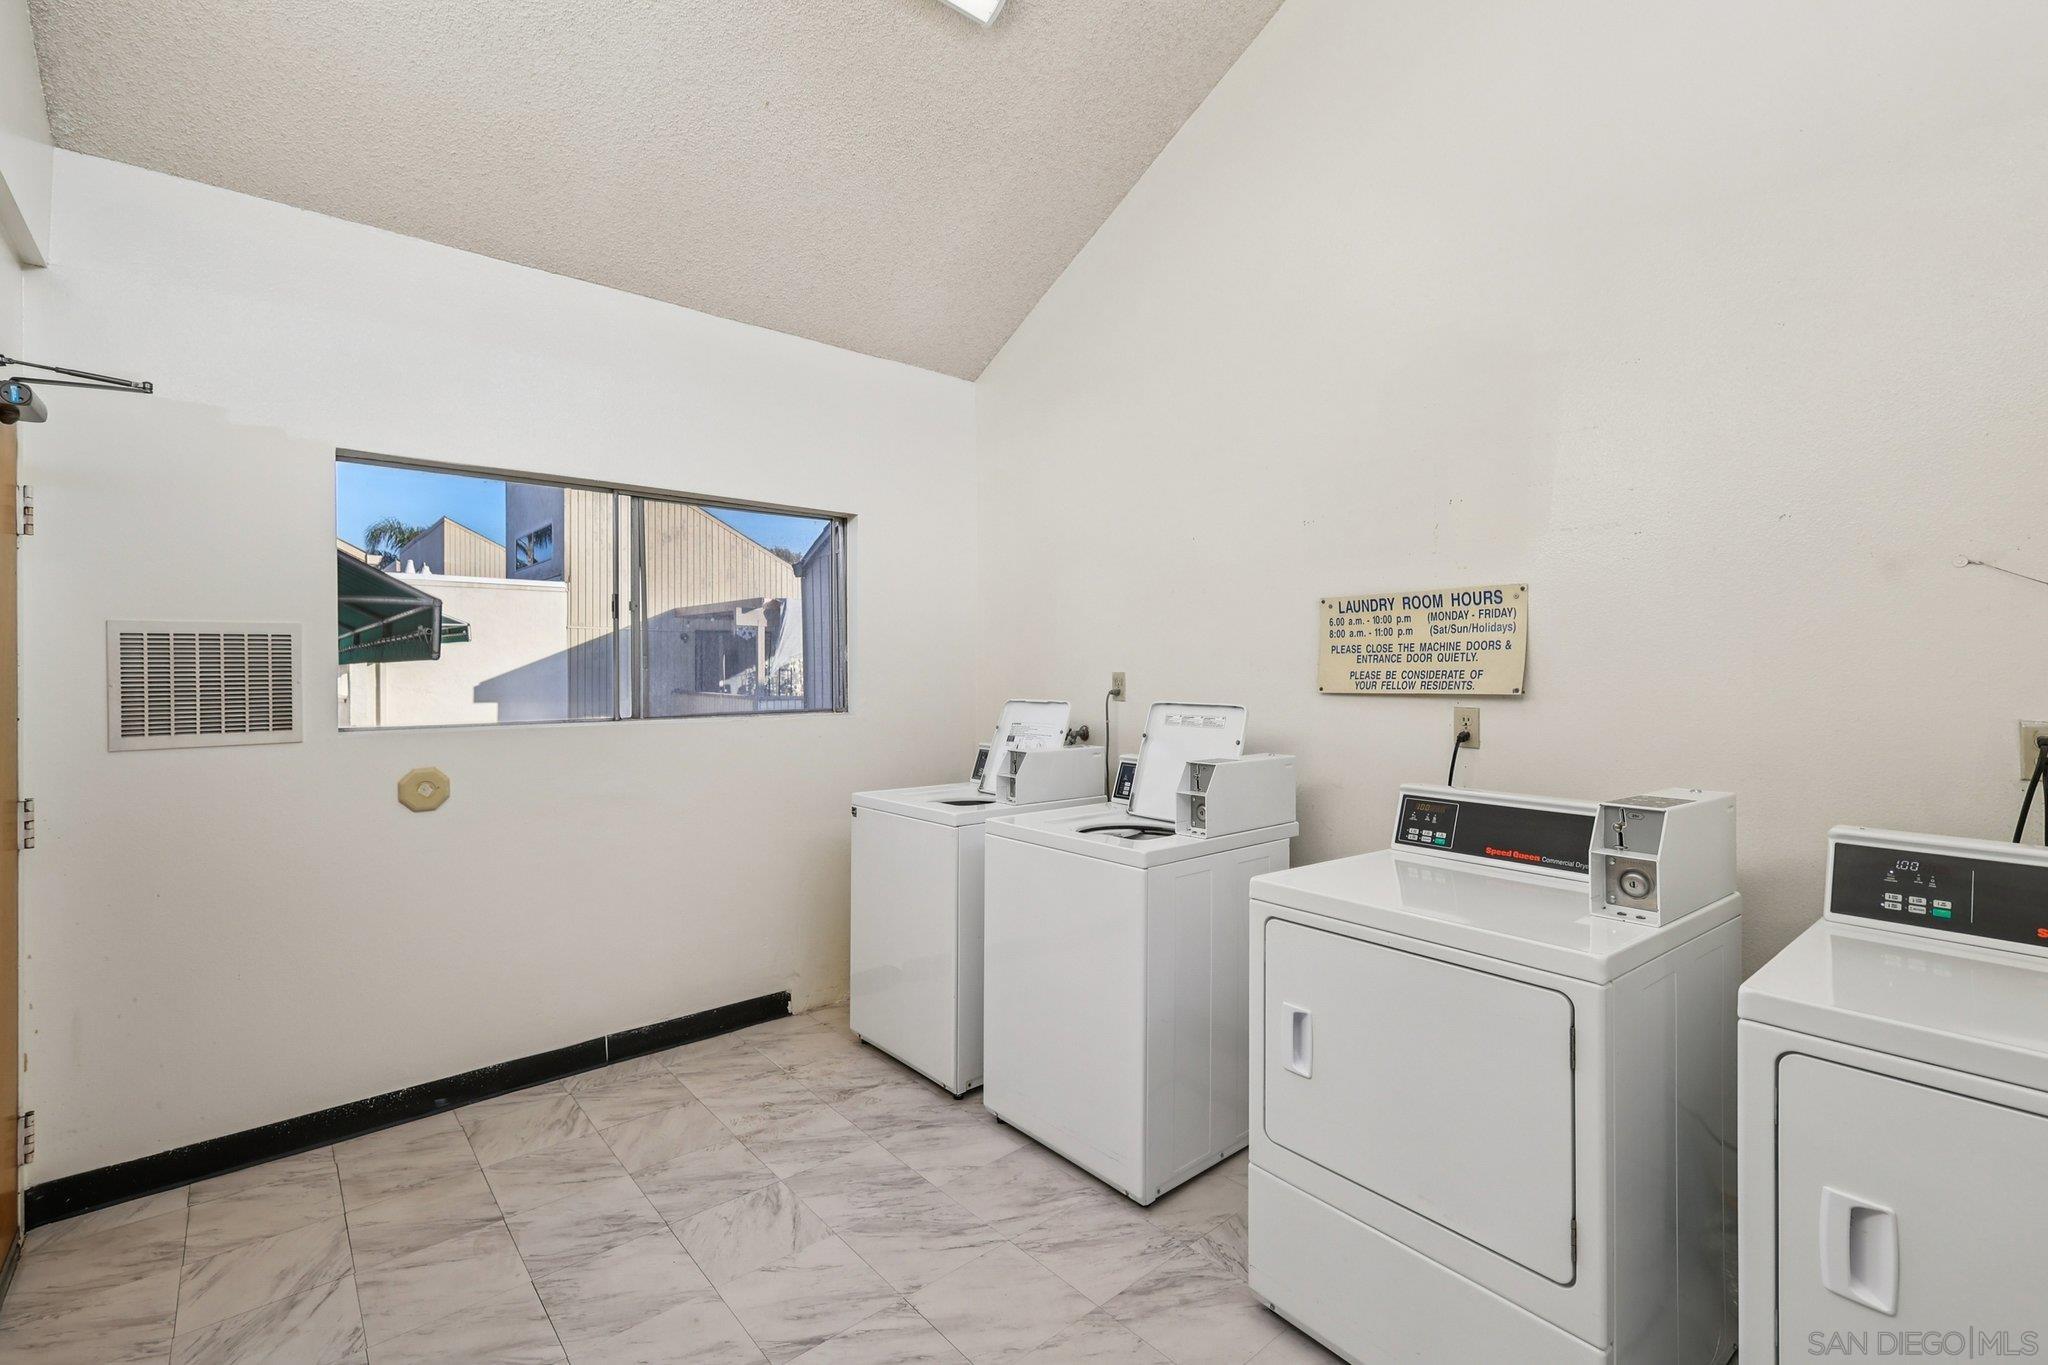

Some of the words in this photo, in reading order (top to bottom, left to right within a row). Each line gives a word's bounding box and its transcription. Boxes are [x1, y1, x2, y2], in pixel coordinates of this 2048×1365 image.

[1338, 597, 1395, 614] LAUNDRY
[1402, 593, 1444, 610] ROOM
[1451, 589, 1504, 607] HOURS
[1348, 617, 1365, 626] a.m.
[1372, 614, 1393, 625] 10:00
[1427, 610, 1470, 624] (MONDAY
[1478, 607, 1517, 620] FRIDAY)
[1329, 629, 1346, 639] 8:00
[1349, 630, 1366, 638] a.m.
[1374, 627, 1394, 637] 11:00
[1429, 621, 1517, 637] (Sat/Sun/Holidays)
[1331, 644, 1362, 654] PLEASE
[1365, 643, 1394, 654] CLOSE
[1397, 642, 1415, 653] THE
[1419, 641, 1462, 652] MACHINE
[1466, 640, 1502, 651] DOORS
[1504, 640, 1512, 650] &
[1356, 653, 1402, 664] ENTRANCE
[1406, 653, 1433, 663] DOOR
[1436, 652, 1479, 663] QUIETLY.
[1349, 670, 1382, 680] PLEASE
[1385, 670, 1397, 680] BE
[1400, 669, 1465, 680] CONSIDERATE
[1469, 669, 1484, 680] OF
[1354, 680, 1378, 690] YOUR
[1380, 680, 1417, 690] FELLOW
[1419, 680, 1475, 690] RESIDENTS.
[1485, 846, 1512, 857] Speed
[1512, 850, 1541, 862] Queen
[1541, 856, 1575, 868] Commercial
